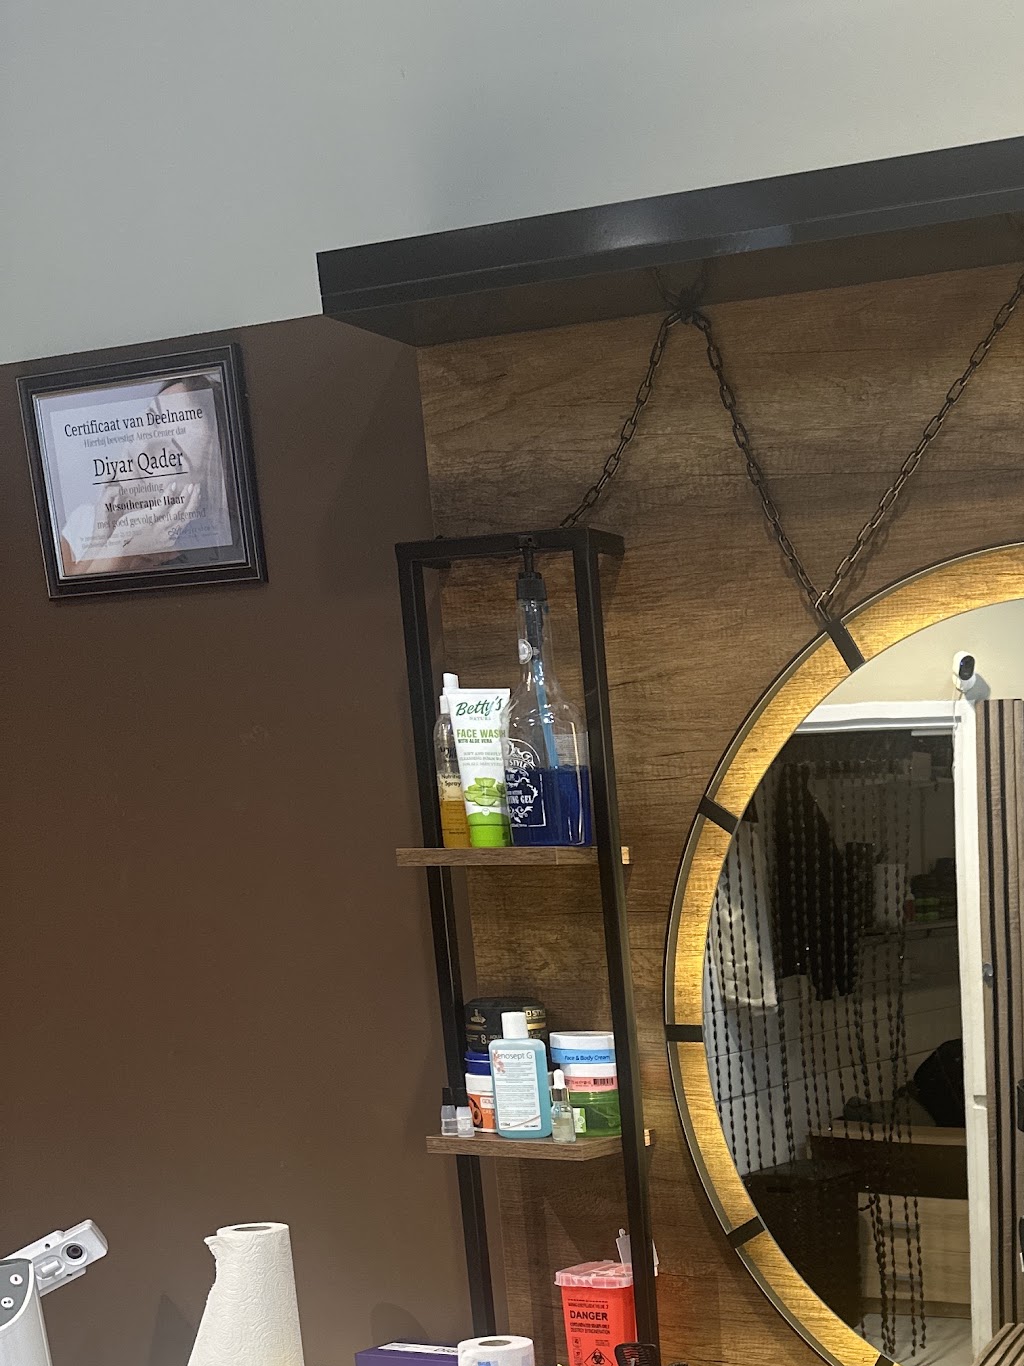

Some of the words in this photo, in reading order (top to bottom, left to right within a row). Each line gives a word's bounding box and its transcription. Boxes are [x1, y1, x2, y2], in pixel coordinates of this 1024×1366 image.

[64, 419, 120, 438] Certificaat
[122, 416, 144, 429] van
[145, 407, 203, 427] Deelname
[93, 456, 134, 480] Diyar
[137, 447, 184, 475] Qader
[105, 497, 161, 513] Mesotherapie
[163, 494, 185, 506] Haar
[456, 696, 503, 716] Betty's
[456, 729, 477, 738] FACE
[480, 729, 506, 738] WASH
[480, 1034, 487, 1044] 8
[526, 1051, 533, 1059] G
[570, 1310, 609, 1321] DANGER
